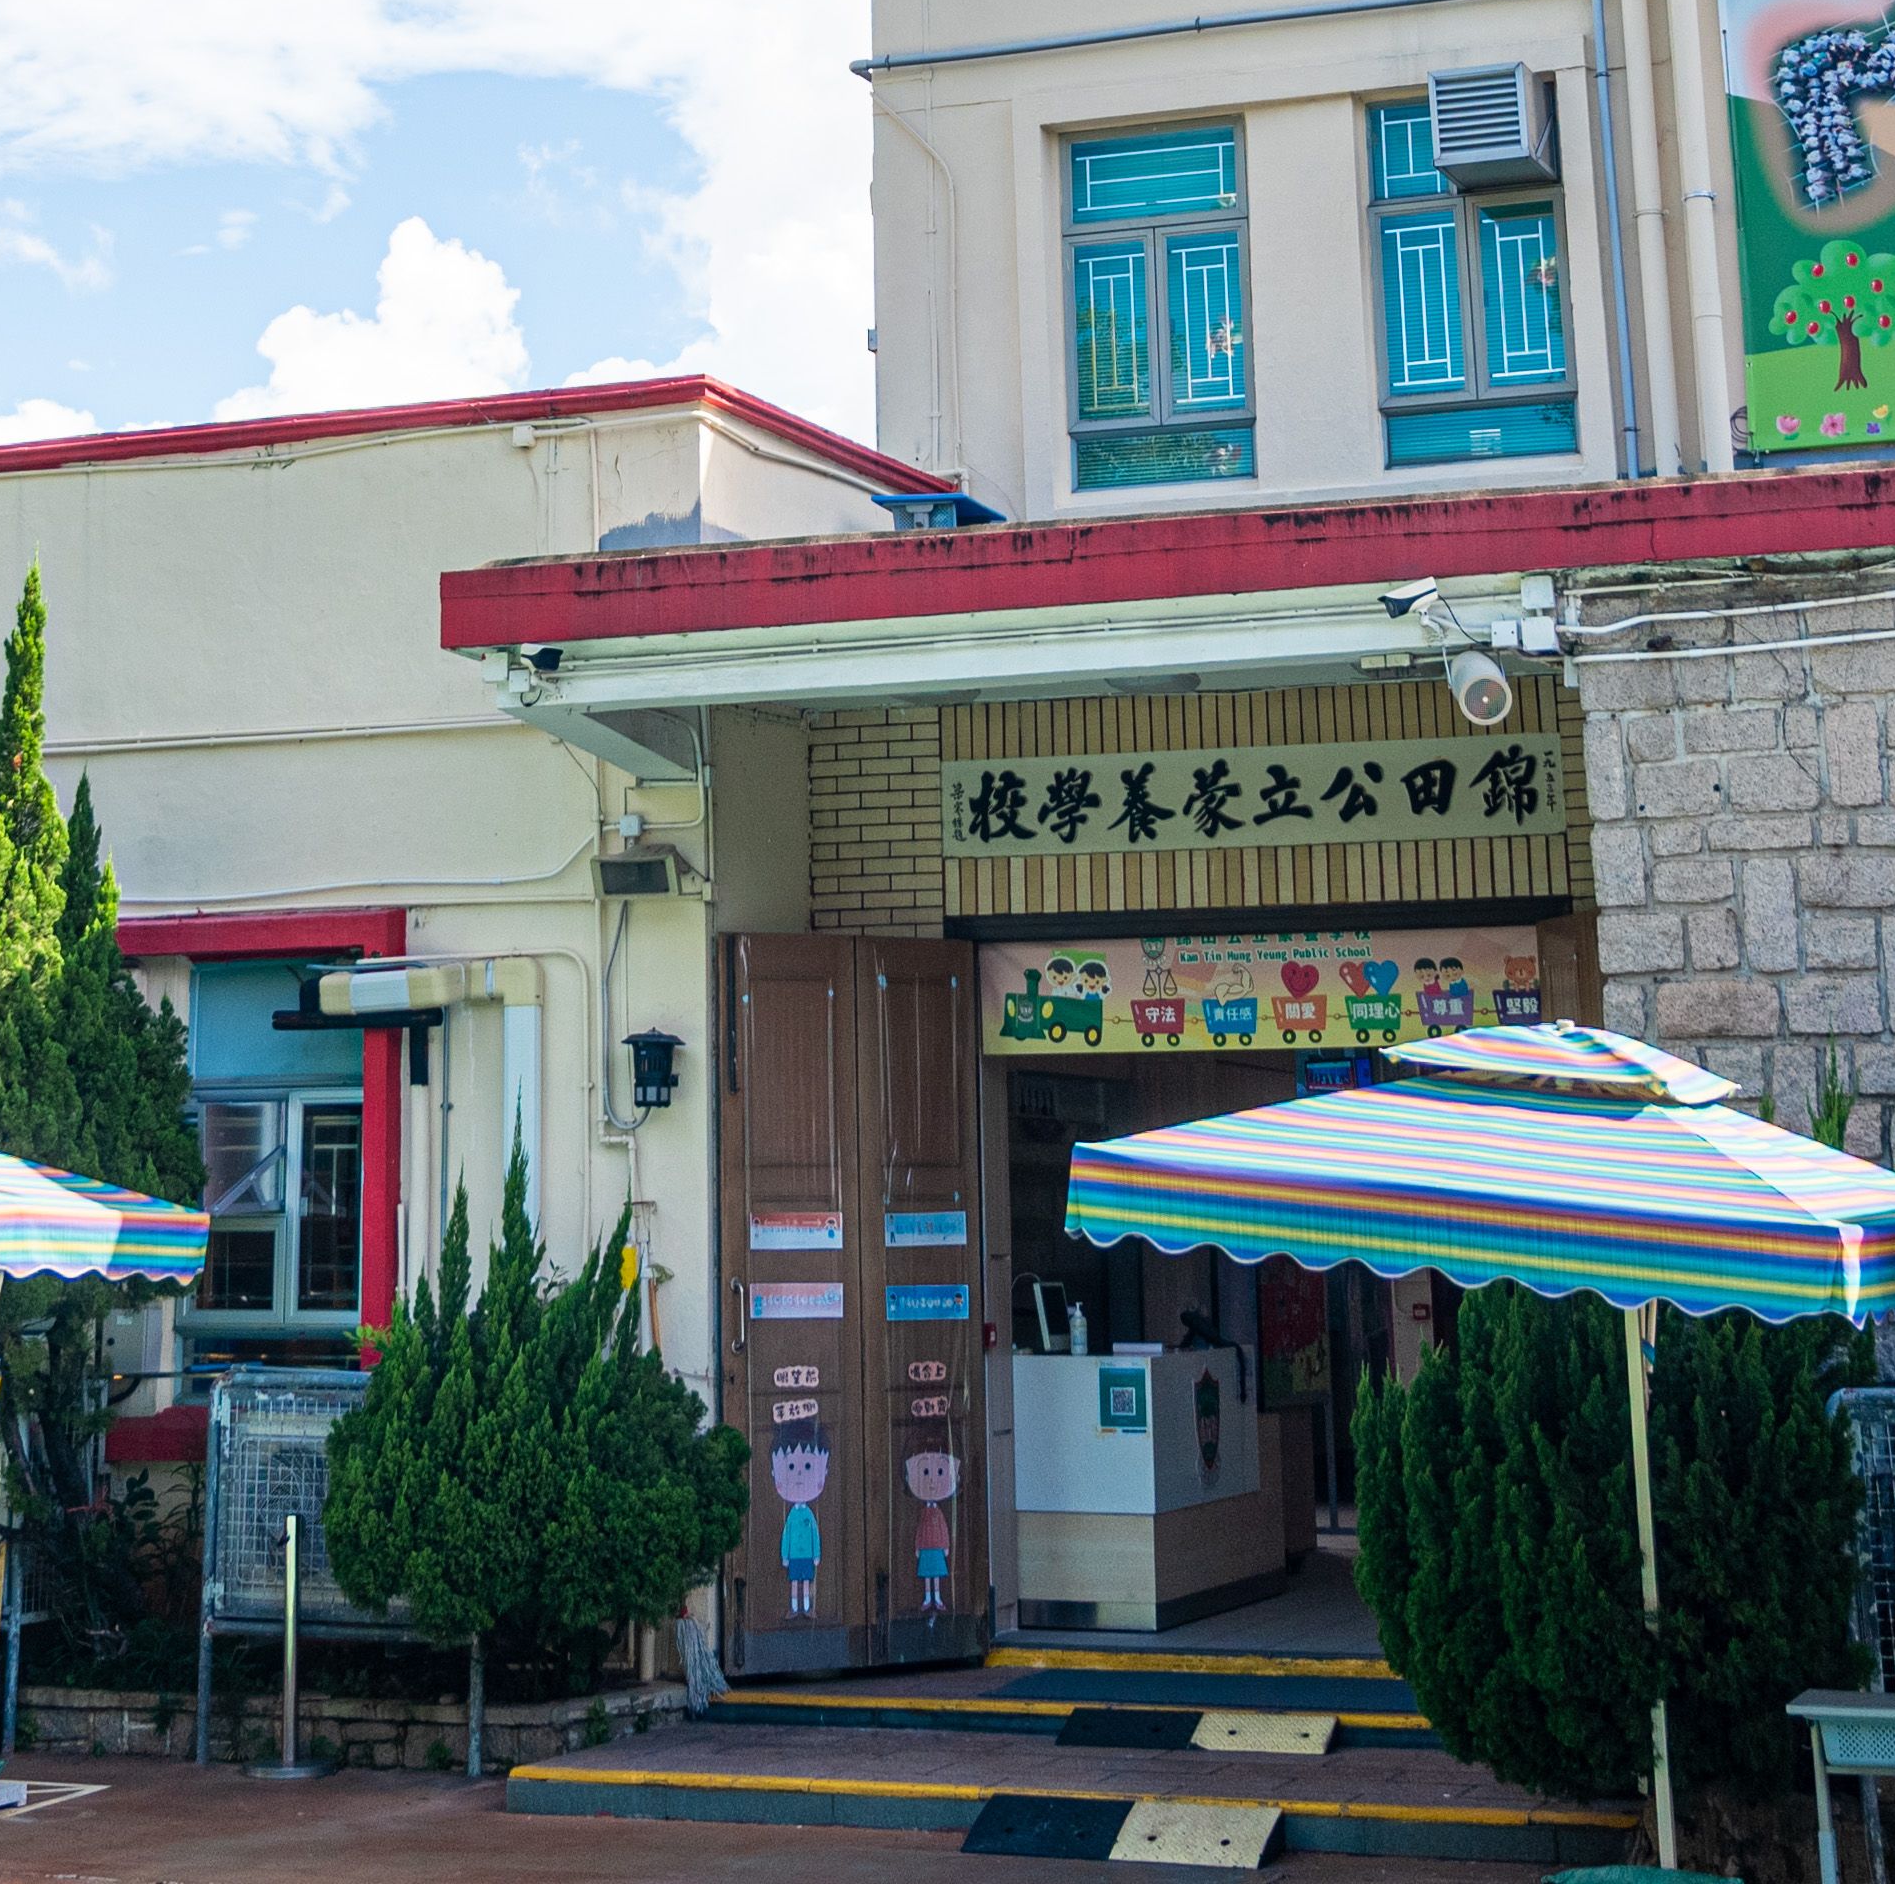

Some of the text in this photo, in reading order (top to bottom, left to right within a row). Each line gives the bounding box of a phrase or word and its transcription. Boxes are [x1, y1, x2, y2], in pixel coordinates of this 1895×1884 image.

[968, 743, 1539, 844] 錦田公立蒙養學校
[1180, 951, 1199, 963] Kam
[1204, 949, 1222, 962] Tin
[1257, 947, 1288, 962] Yeung
[1293, 946, 1330, 959] Public
[1336, 945, 1372, 958] School
[1213, 1006, 1253, 1021] 責任感
[1285, 1002, 1317, 1020] 關愛
[1352, 1001, 1402, 1019] 同理心
[1432, 998, 1465, 1016] 尊重
[1505, 996, 1539, 1015] 堅毅
[1145, 1006, 1177, 1024] 守法
